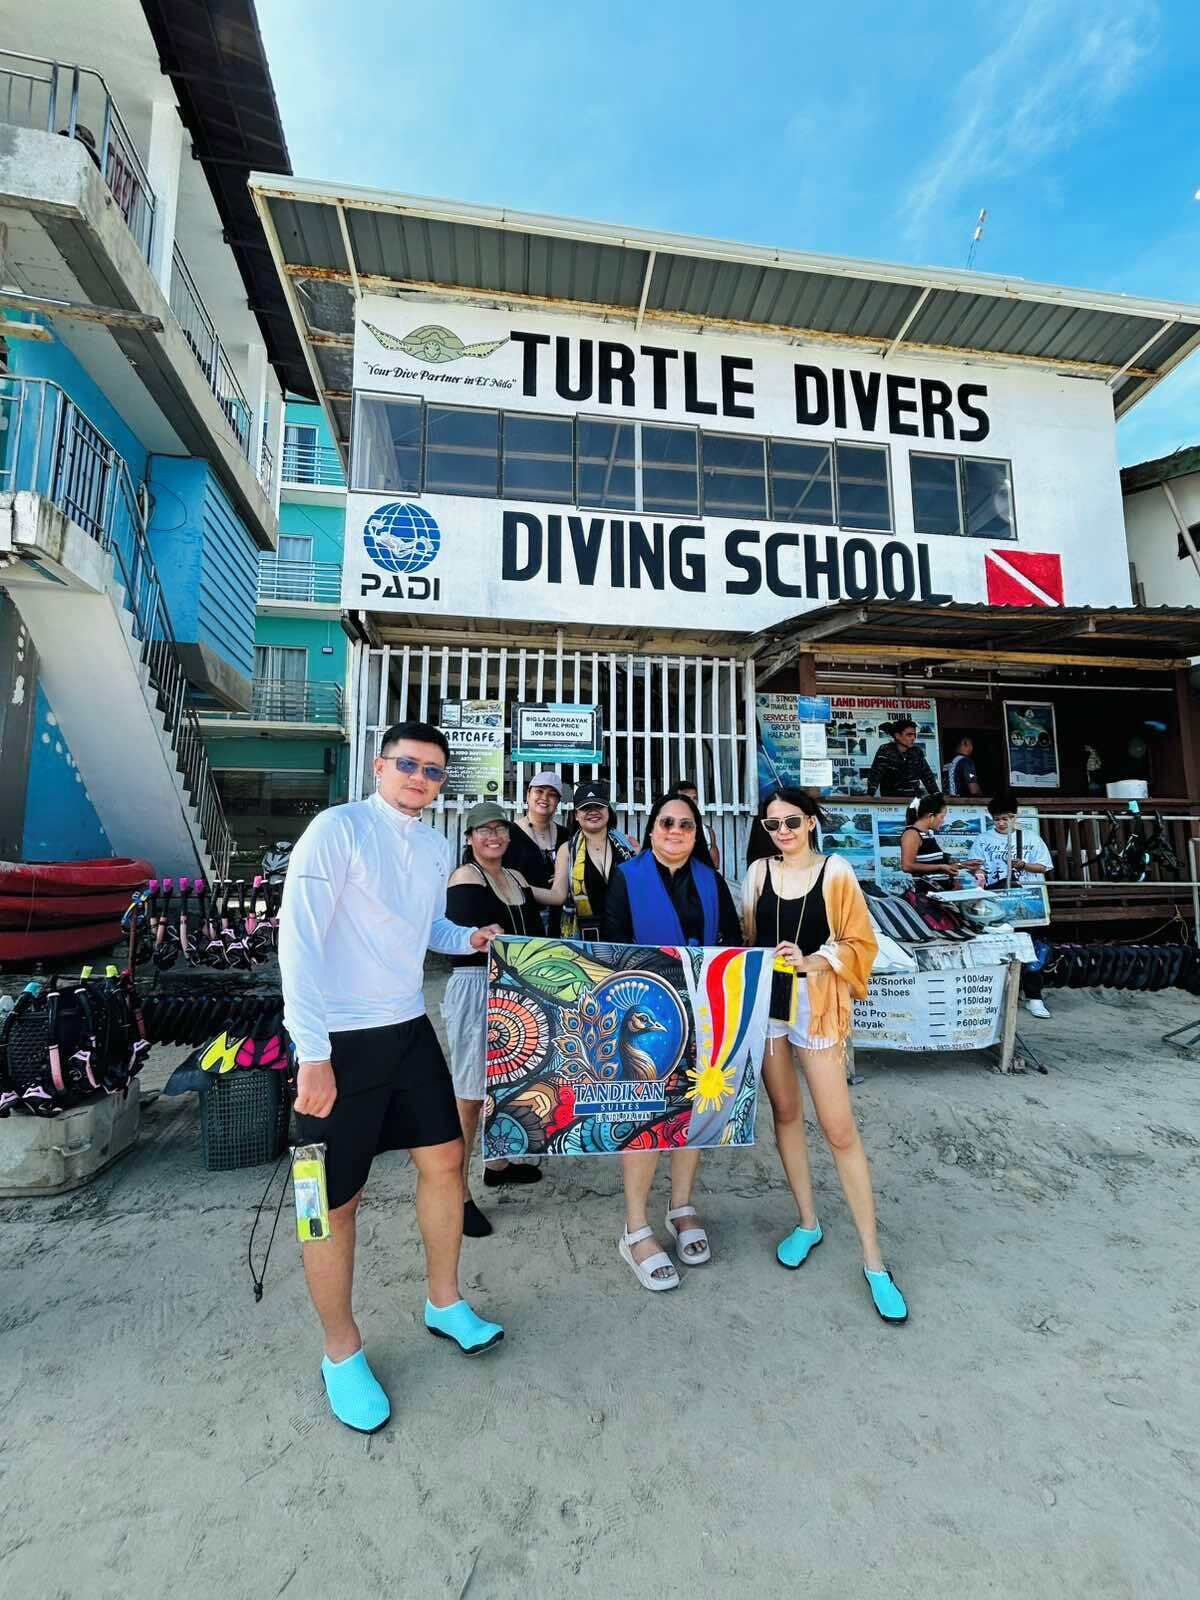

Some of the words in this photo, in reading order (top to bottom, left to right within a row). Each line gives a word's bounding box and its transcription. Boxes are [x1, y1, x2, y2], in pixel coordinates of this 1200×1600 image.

[393, 366, 419, 380] Dive
[420, 369, 462, 384] Partner
[464, 375, 474, 385] in
[475, 376, 489, 387] El
[510, 330, 755, 419] TURTLE
[794, 363, 990, 442] DIVERS
[502, 510, 706, 593] DIVING
[724, 528, 953, 602] SCHOOL
[361, 573, 440, 601] PADI
[831, 697, 855, 708] LAND
[857, 698, 897, 709] HOPPING
[899, 699, 931, 710] TOURS
[763, 713, 788, 722] SERVICE
[848, 711, 854, 720] A
[888, 712, 905, 721] TOUR
[771, 723, 791, 731] GROUP
[444, 731, 495, 742] ARTCAFE
[849, 758, 856, 767] C
[867, 976, 916, 986] sk/Snorkel
[963, 974, 994, 983] 100/day
[881, 987, 910, 997] Shoes
[963, 985, 993, 994] 100/day
[963, 996, 993, 1005] 150/day
[853, 1008, 867, 1017] Go
[870, 1009, 887, 1018] Pro
[962, 1017, 993, 1027] 600/day
[573, 1083, 665, 1102] TANDIKAN
[601, 1103, 639, 1111] SUITES
